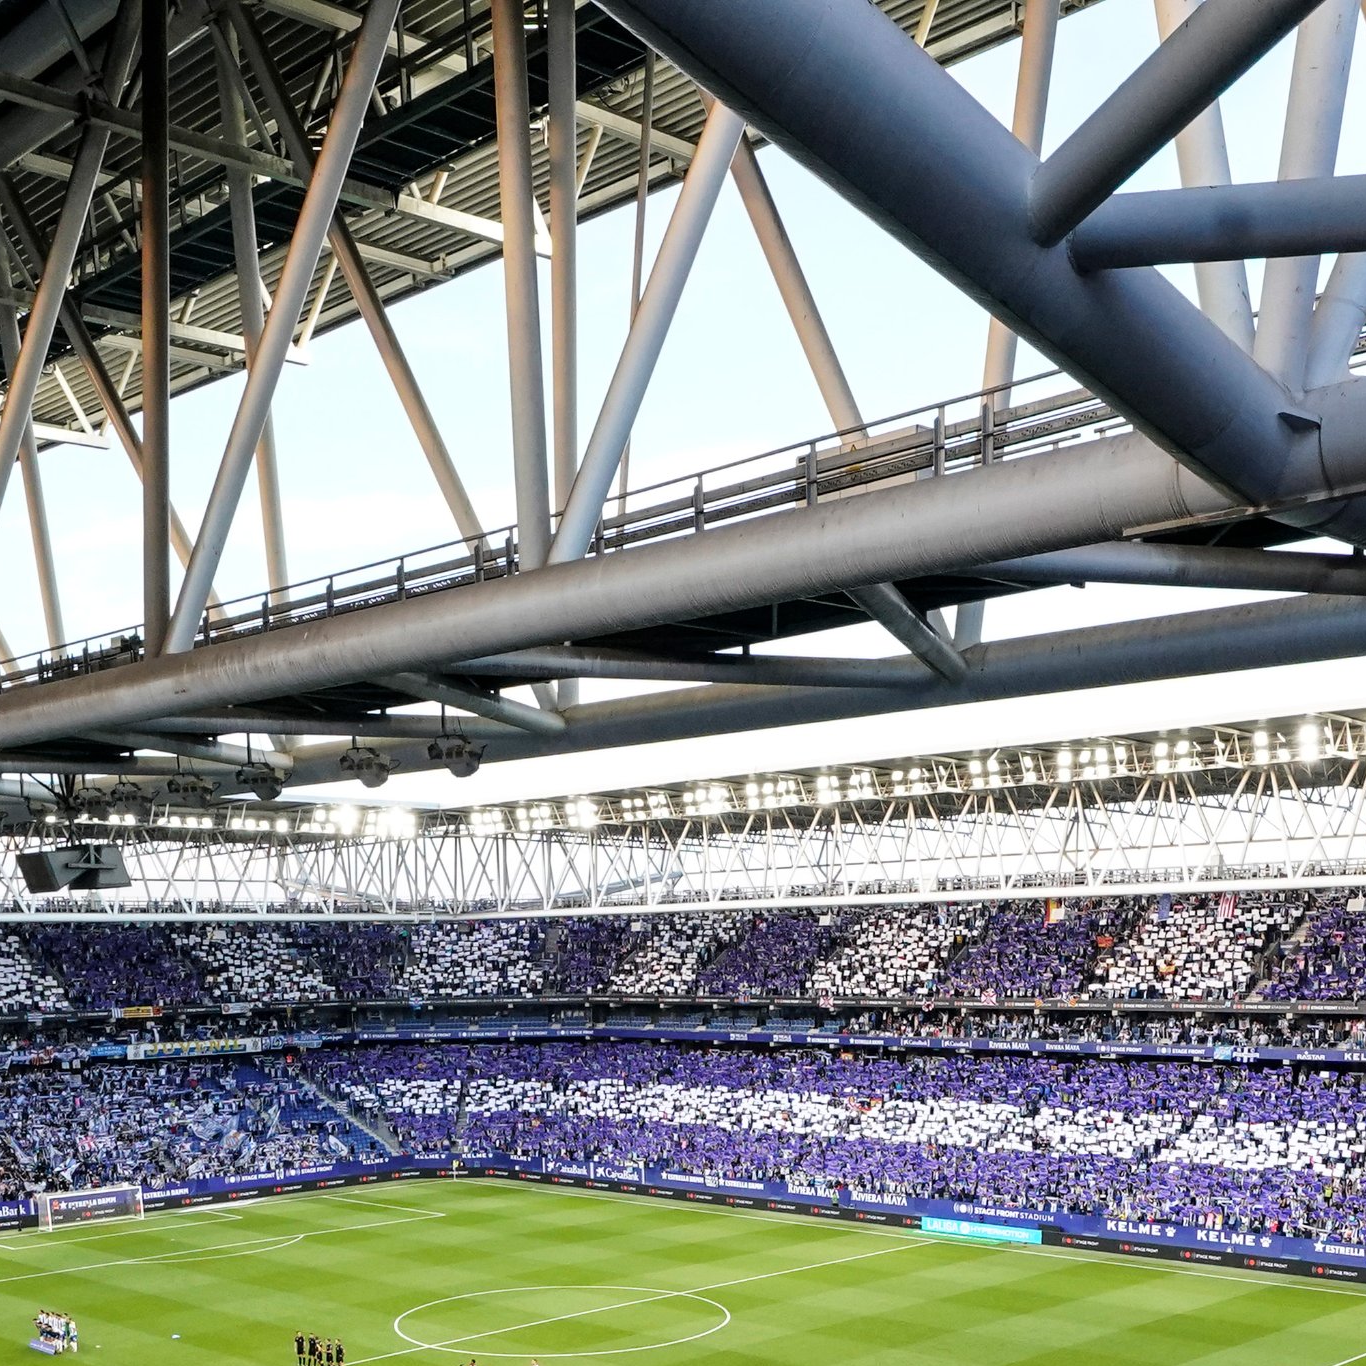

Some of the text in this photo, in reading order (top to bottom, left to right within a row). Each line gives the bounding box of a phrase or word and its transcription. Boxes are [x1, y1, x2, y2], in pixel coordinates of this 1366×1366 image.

[363, 1158, 384, 1166] KELME
[605, 1166, 640, 1181] CaixaBank
[143, 1188, 189, 1200] ESTRELLA DAMM
[788, 1183, 840, 1199] RIVIERA MAYA
[852, 1191, 907, 1206] RIVIERA MAYA
[974, 1206, 1054, 1222] STAGE FRONT STADIUM
[1106, 1220, 1161, 1236] KELME
[1197, 1230, 1255, 1246] KELME
[1325, 1245, 1365, 1258] ESTRELLA
